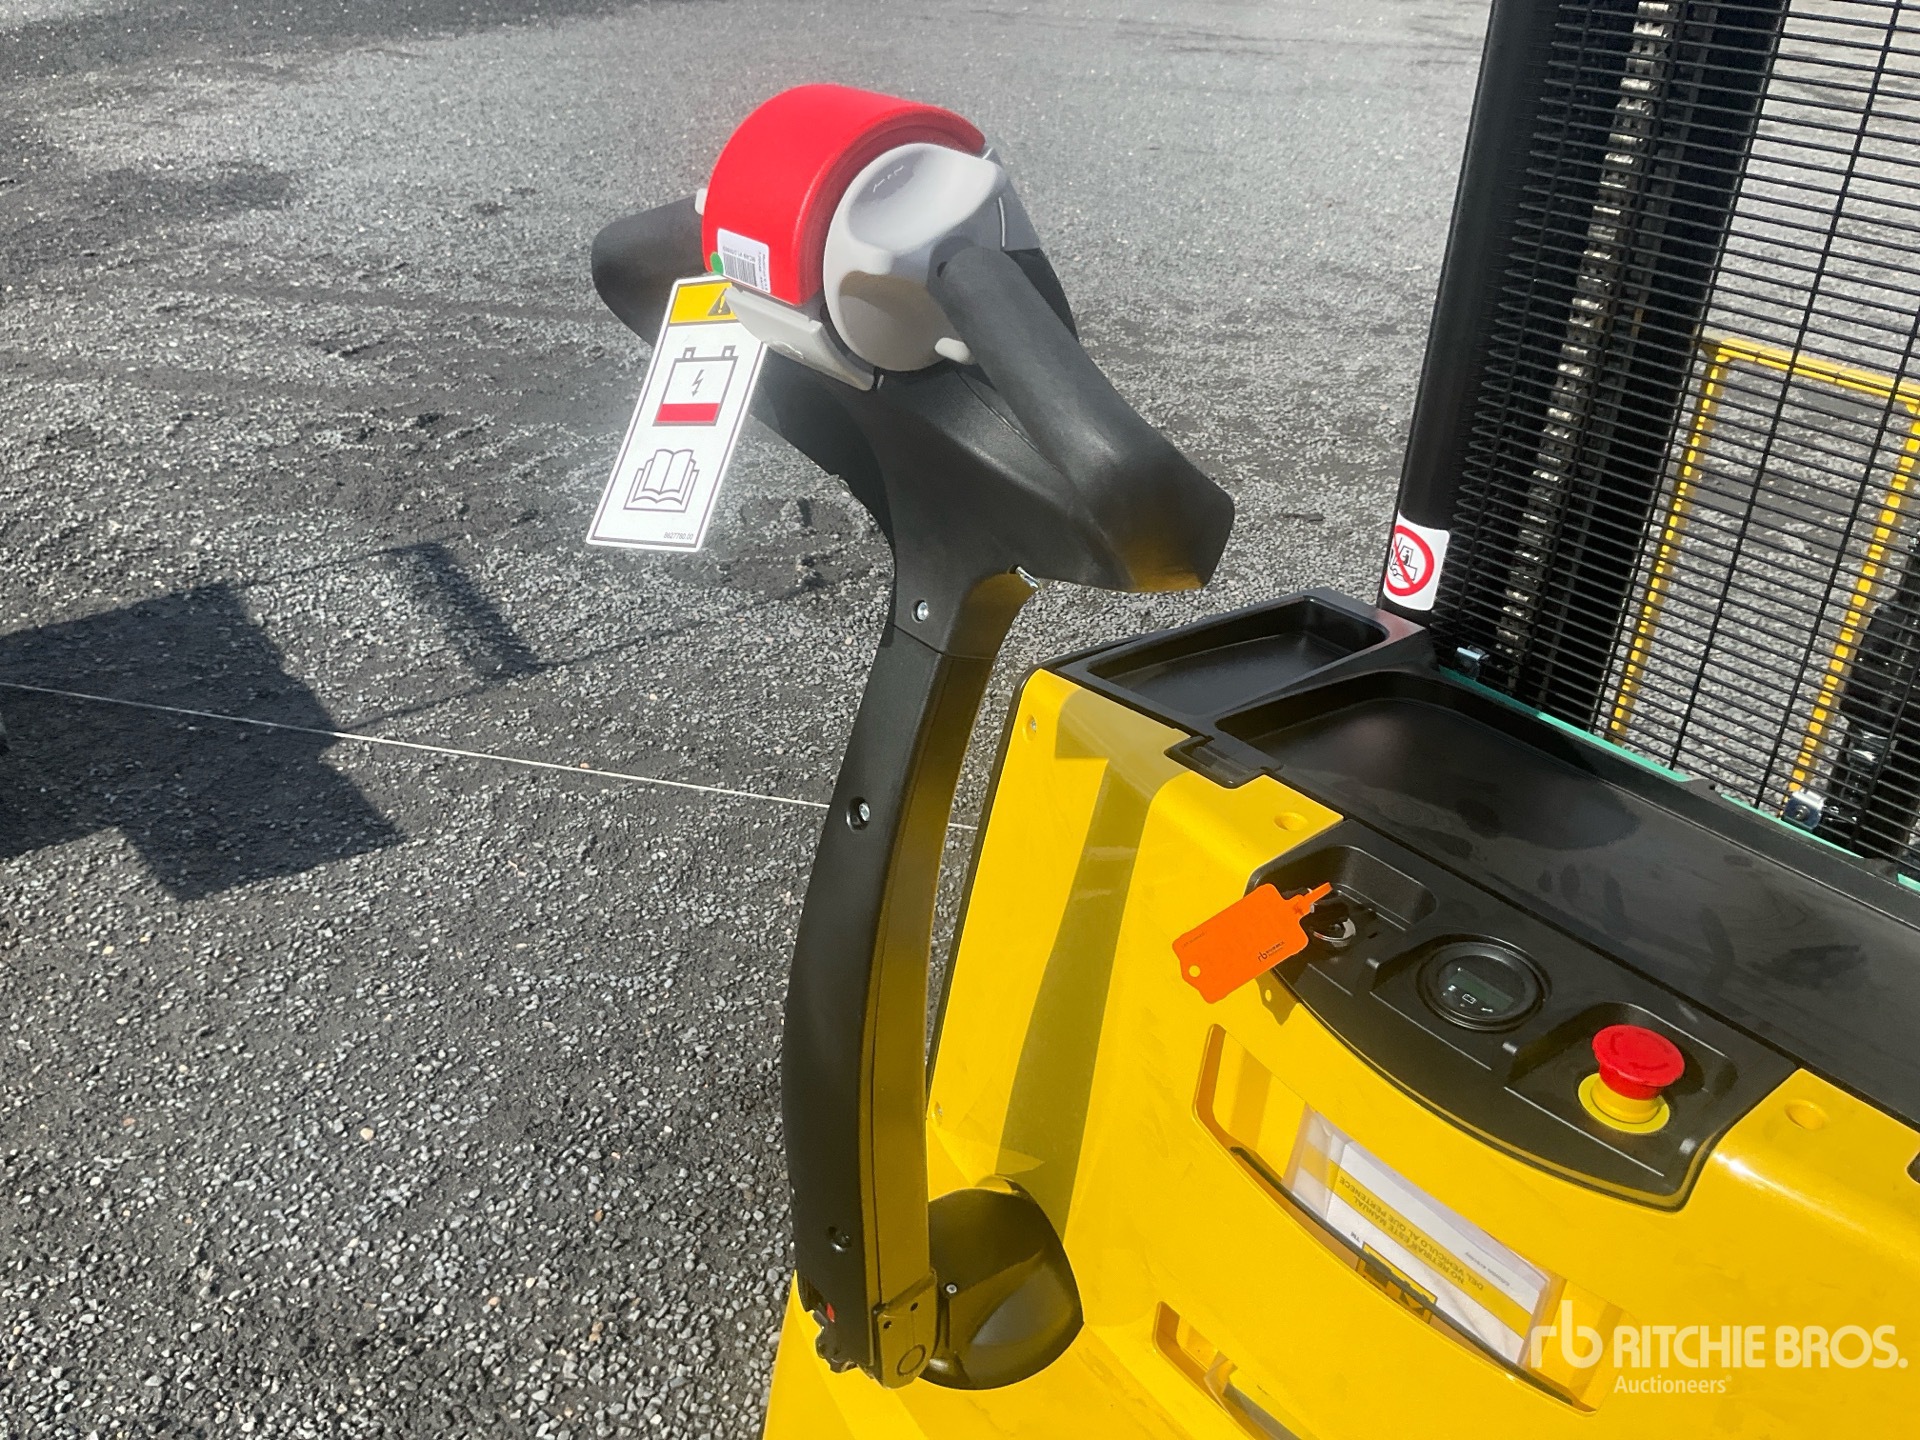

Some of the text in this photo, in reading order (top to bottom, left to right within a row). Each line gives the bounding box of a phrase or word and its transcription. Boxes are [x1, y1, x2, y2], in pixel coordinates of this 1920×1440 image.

[1338, 1175, 1388, 1218] PERTENECE
[1353, 1194, 1388, 1227] MANUAL
[1386, 1213, 1407, 1232] QUE
[1387, 1223, 1411, 1244] ESTE
[1408, 1228, 1421, 1242] AL
[1410, 1240, 1450, 1273] RETIRAR
[1449, 1270, 1465, 1285] NO
[1466, 1272, 1484, 1291] DEL
